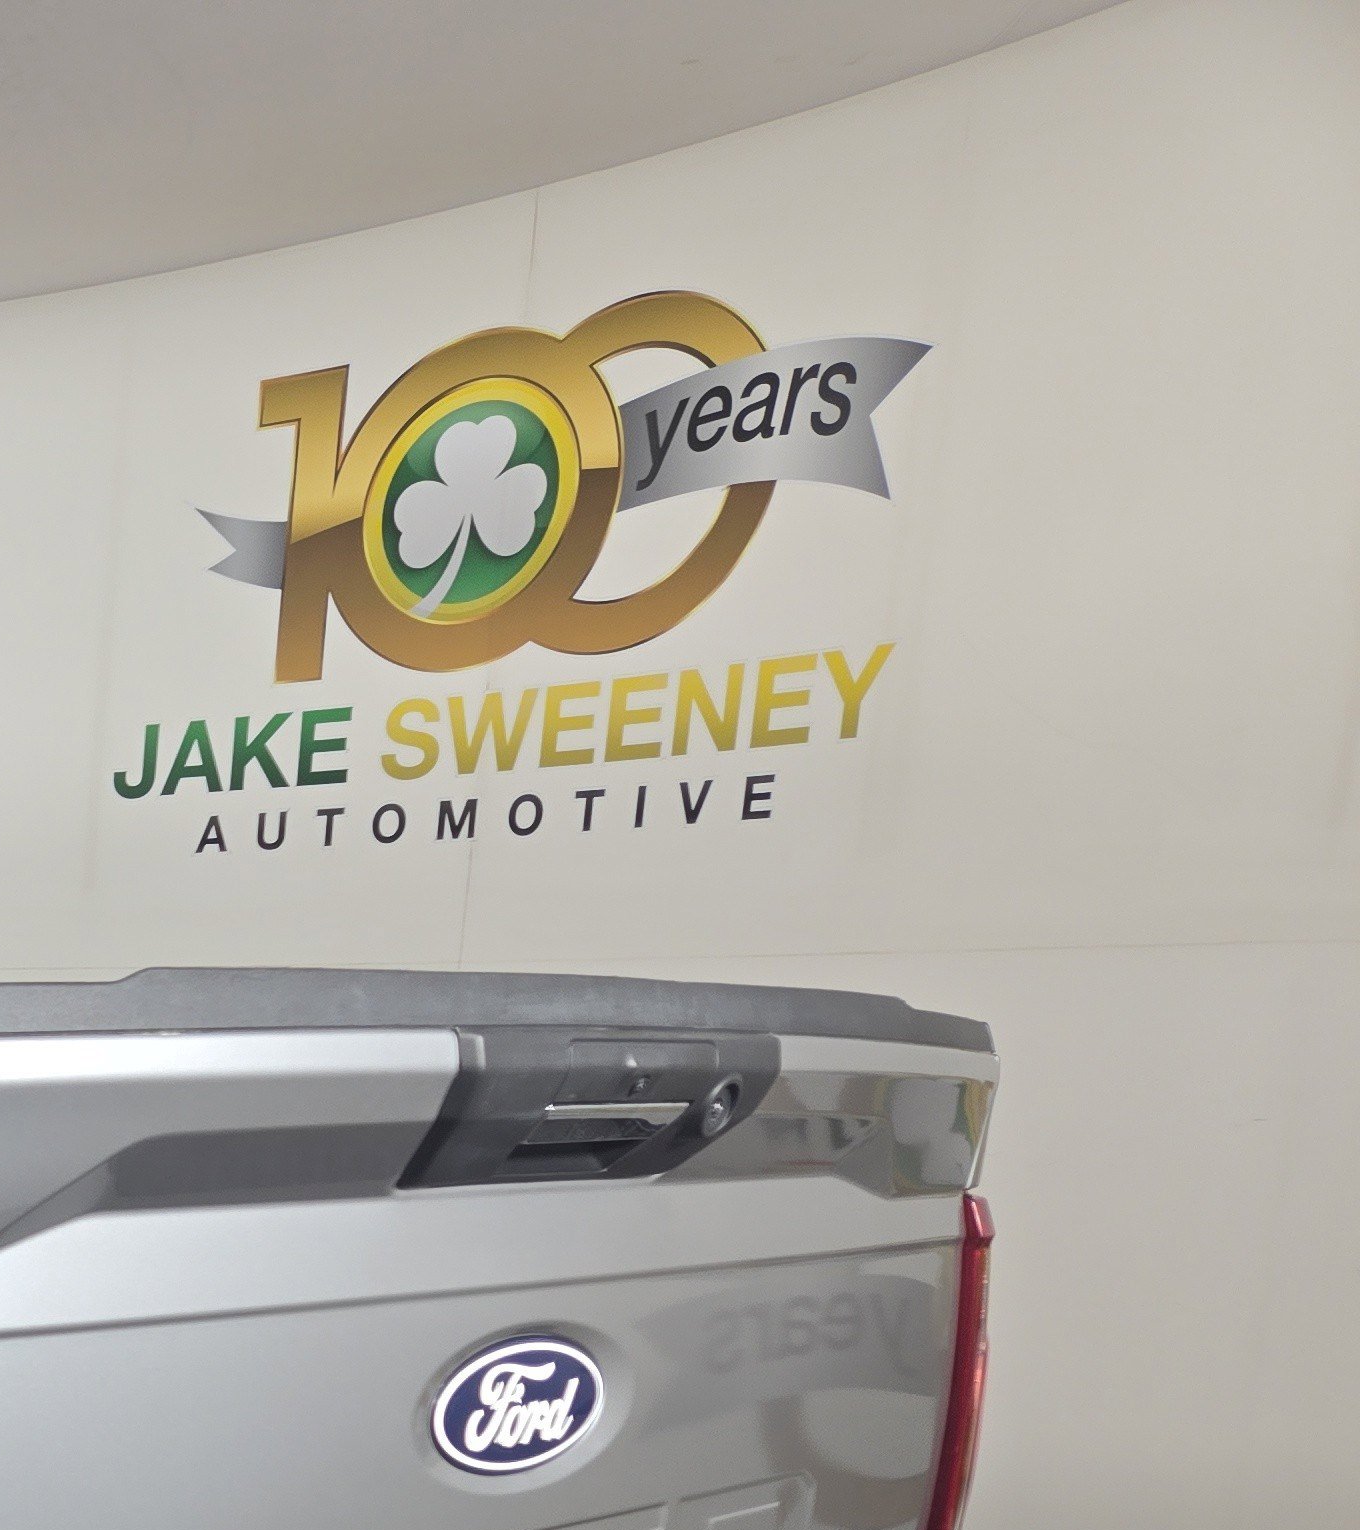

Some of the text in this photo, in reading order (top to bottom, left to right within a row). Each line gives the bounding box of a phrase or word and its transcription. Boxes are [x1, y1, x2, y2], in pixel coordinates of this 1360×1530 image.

[256, 290, 778, 684] 100
[636, 359, 857, 491] years
[114, 642, 895, 799] JAKE SWEENEY
[196, 774, 776, 855] AUTOMOTIVE
[464, 1361, 580, 1453] Ford
